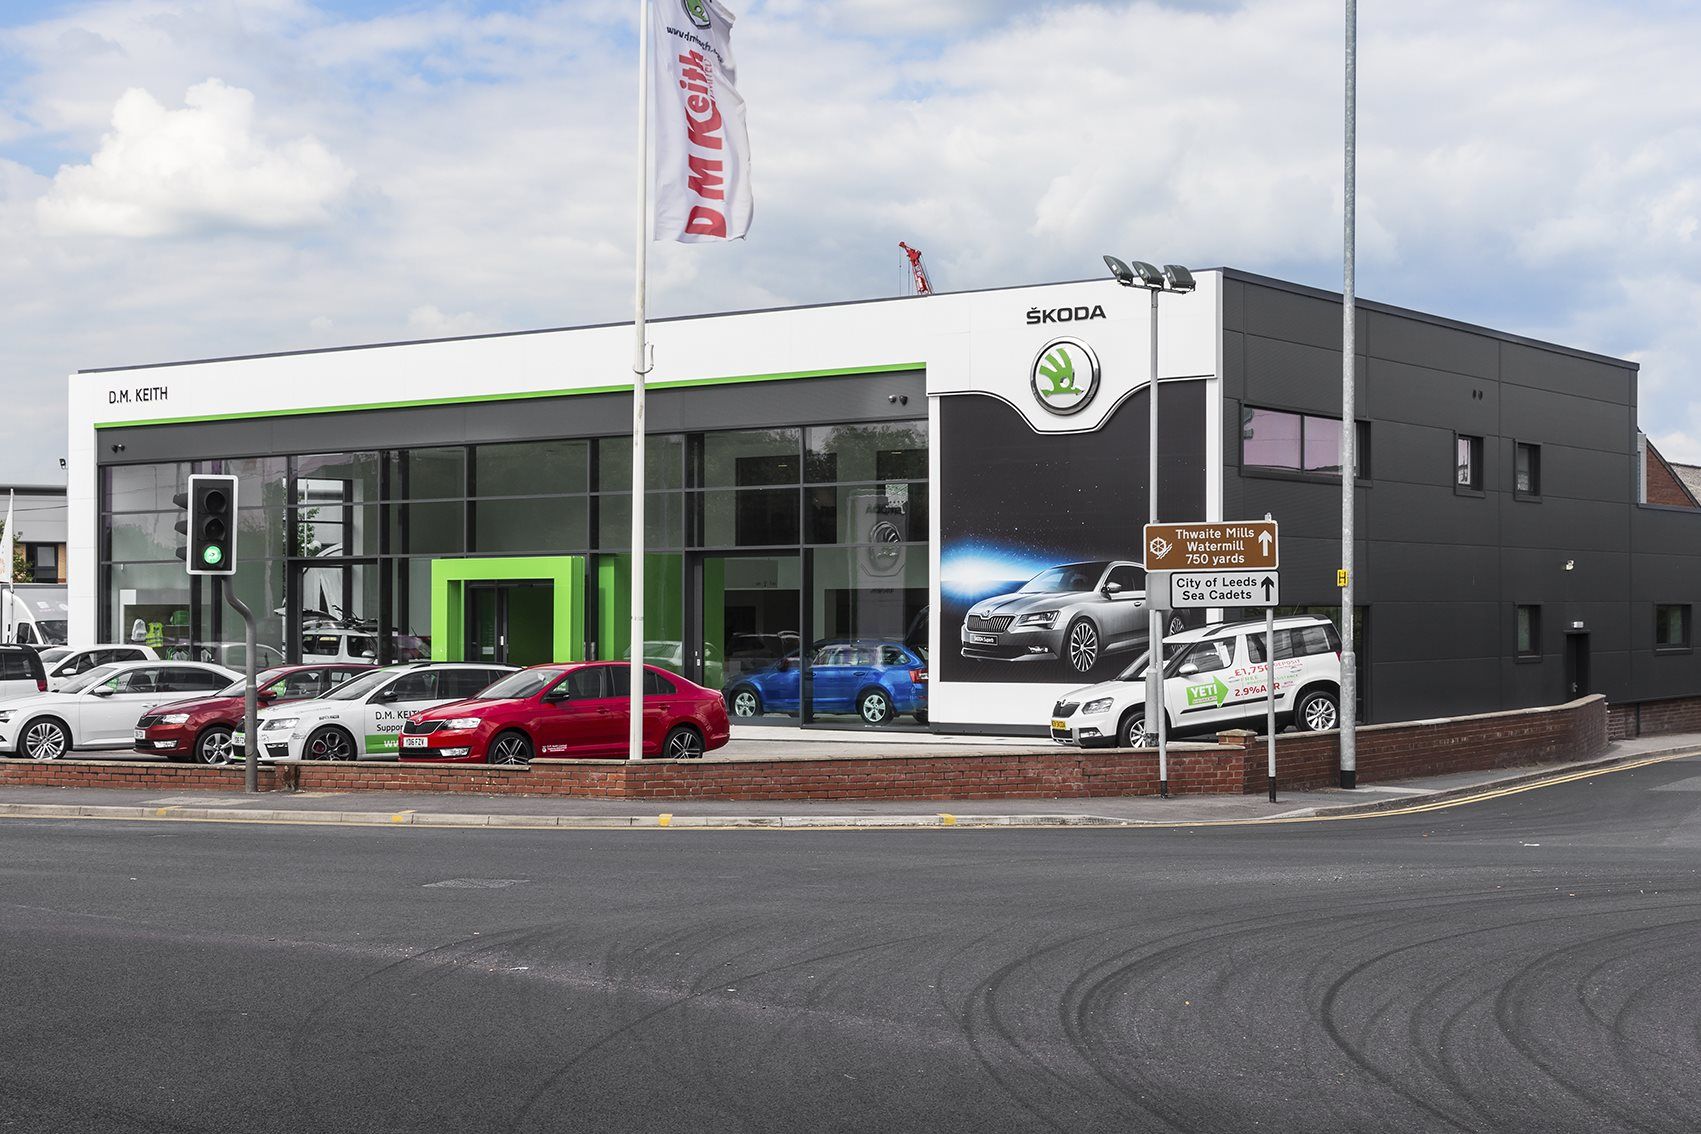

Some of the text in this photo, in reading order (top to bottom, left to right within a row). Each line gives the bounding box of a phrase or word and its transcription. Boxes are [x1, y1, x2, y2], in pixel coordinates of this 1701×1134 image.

[679, 49, 723, 150] Keith
[1026, 305, 1106, 325] ŠKODA
[109, 386, 168, 404] D.M. KEITH
[1176, 528, 1254, 540] Thwaite Mills
[1187, 541, 1244, 552] Watermill
[1186, 554, 1245, 567] 750 yards
[1176, 577, 1257, 590] City of Leeds
[1182, 590, 1252, 600] Sea Cadets
[1191, 684, 1217, 698] YETI
[376, 711, 395, 720] D.M.
[377, 724, 403, 733] Suppor
